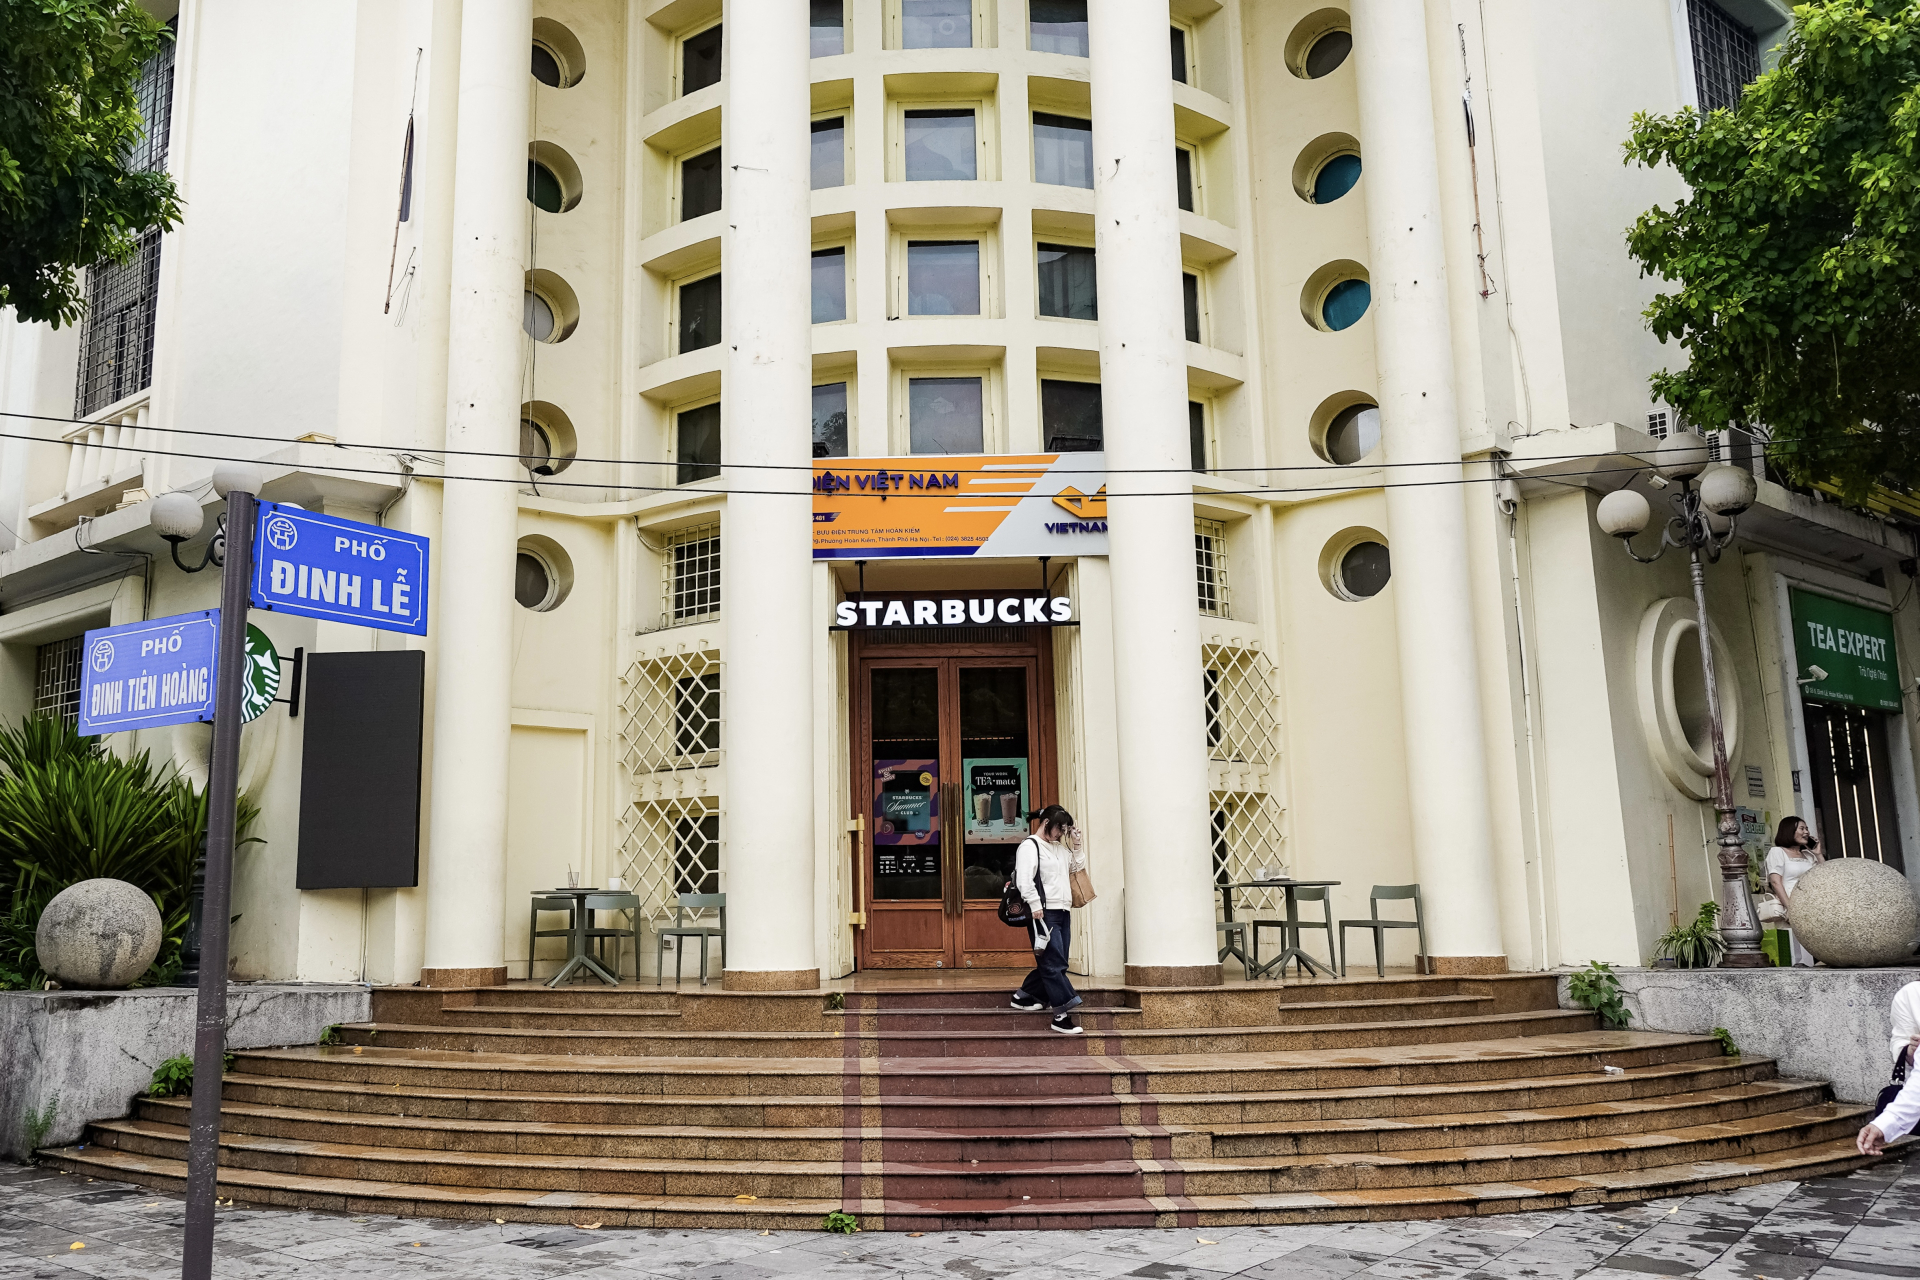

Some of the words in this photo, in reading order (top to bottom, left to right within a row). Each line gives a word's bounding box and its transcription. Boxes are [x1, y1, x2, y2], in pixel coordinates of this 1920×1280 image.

[855, 469, 904, 501] VIỆT
[909, 473, 959, 490] NAM
[335, 535, 389, 561] PHỐ
[270, 559, 362, 608] ĐINH
[372, 567, 411, 617] LỄ
[836, 597, 1072, 626] STARBUCKS
[141, 626, 185, 657] PHỐ
[1807, 621, 1837, 652] TEA
[1838, 628, 1886, 662] EXPERT
[91, 679, 123, 717] ĐINH
[128, 669, 157, 712] TIÊN
[161, 663, 208, 709] HOÀNG
[1794, 773, 1798, 784] 6
[886, 800, 926, 812] Summer
